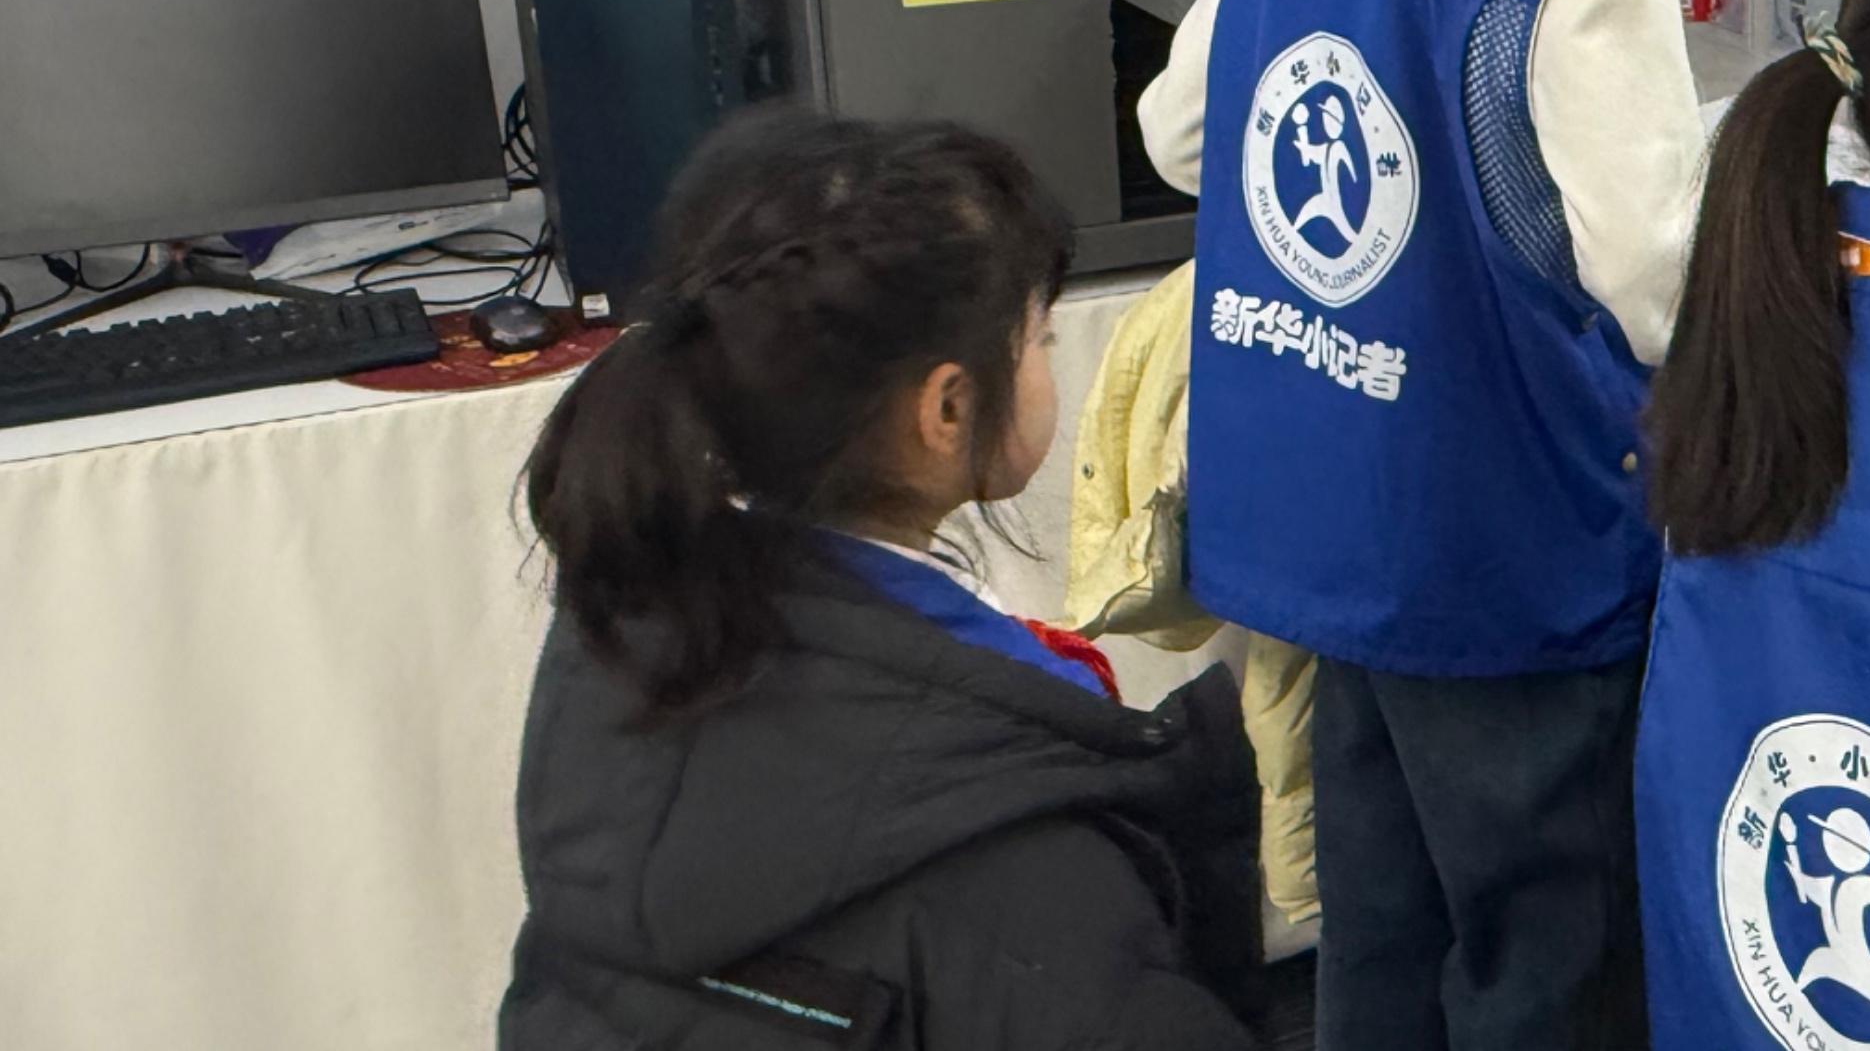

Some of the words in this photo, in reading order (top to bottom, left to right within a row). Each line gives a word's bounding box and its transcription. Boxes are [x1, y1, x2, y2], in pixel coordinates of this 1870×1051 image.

[1256, 186, 1271, 218] XIN
[1265, 218, 1290, 257] HUA
[1211, 288, 1407, 401] 新华小记者
[1742, 918, 1768, 961] XIN
[1758, 966, 1793, 1024] HUA
